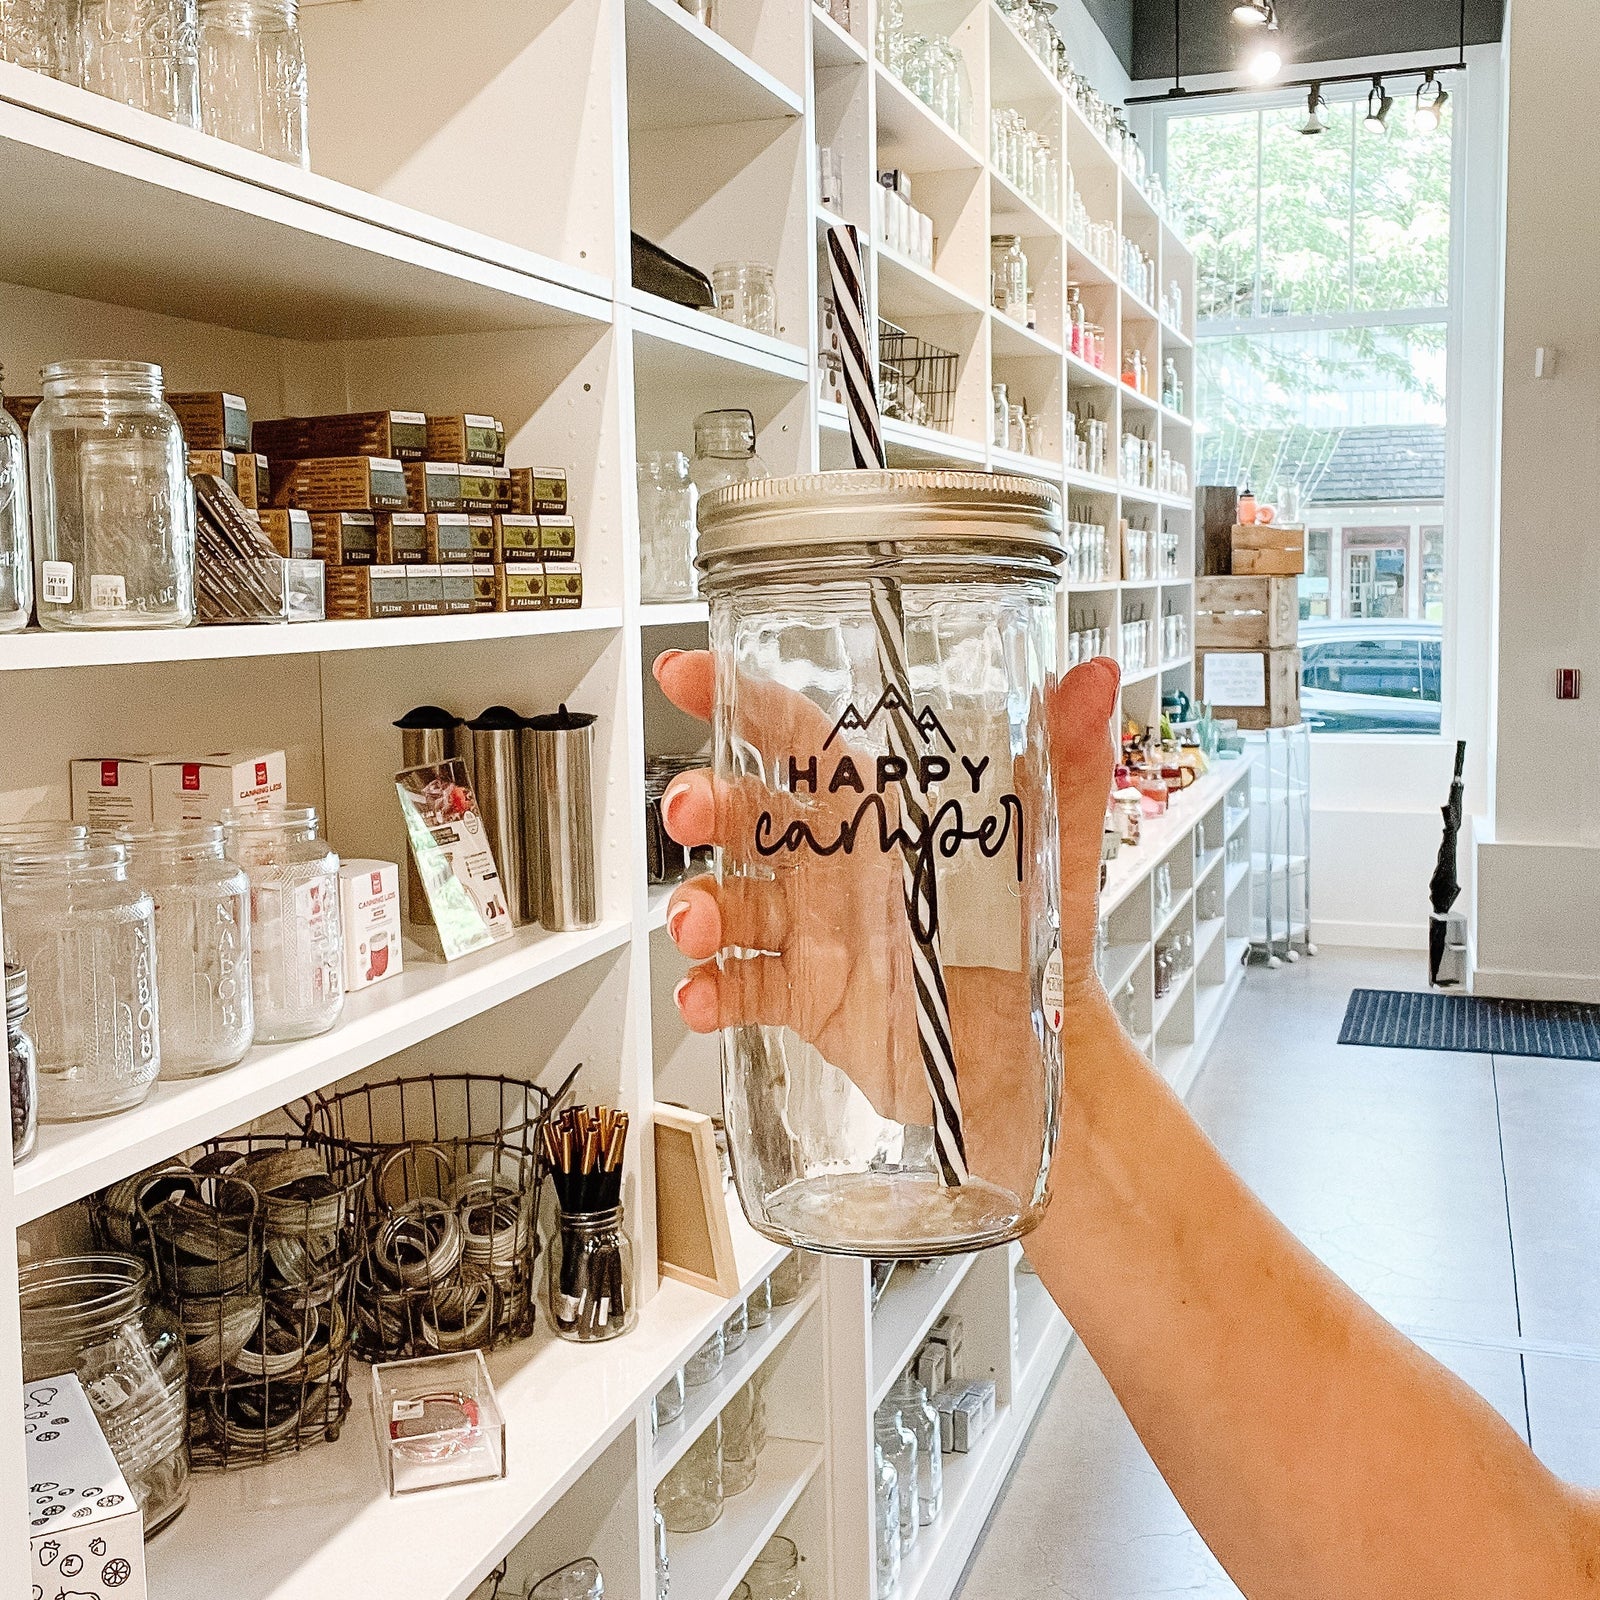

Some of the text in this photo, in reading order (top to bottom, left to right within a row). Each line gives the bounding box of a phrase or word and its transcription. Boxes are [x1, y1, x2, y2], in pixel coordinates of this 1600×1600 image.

[788, 755, 990, 794] HAPPY
[240, 786, 268, 798] CANNING
[754, 793, 1024, 945] camper
[358, 894, 384, 910] CANNING
